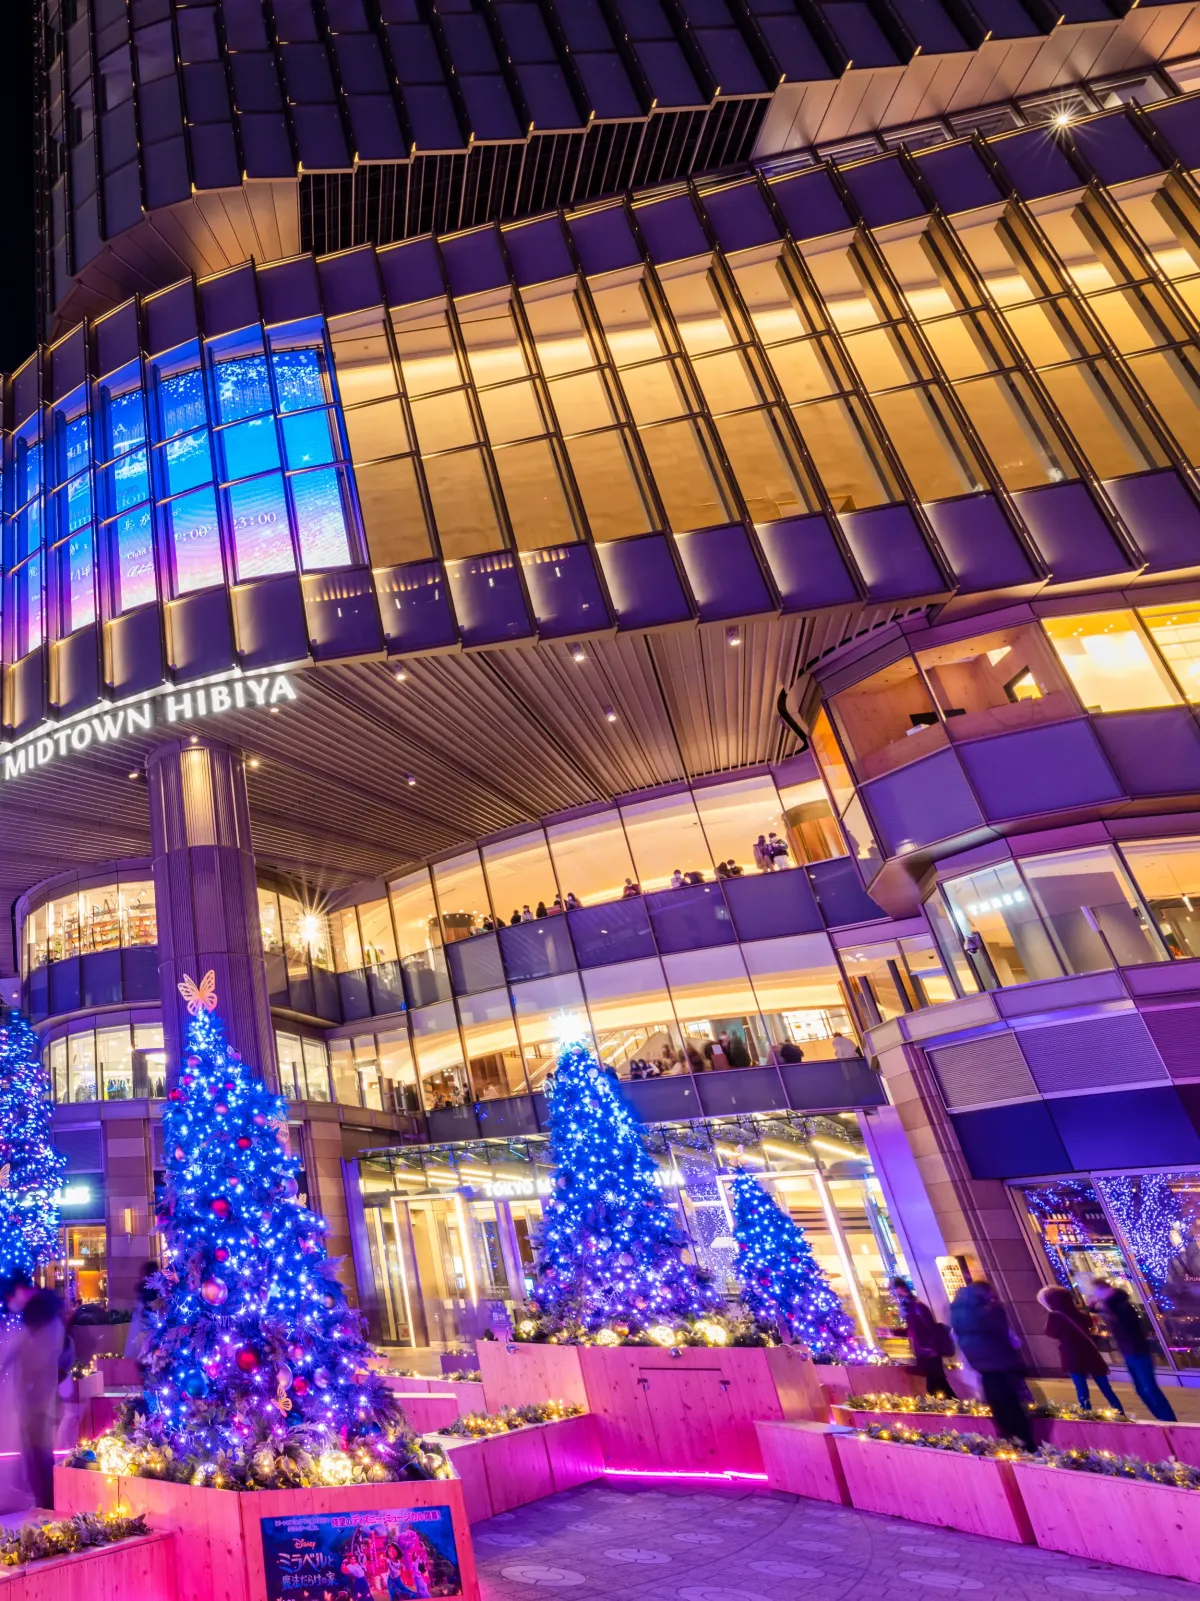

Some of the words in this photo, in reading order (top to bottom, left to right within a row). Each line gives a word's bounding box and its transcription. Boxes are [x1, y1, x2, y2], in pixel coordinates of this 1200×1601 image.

[4, 703, 151, 781] MIDTOWN
[166, 674, 297, 723] HIBIYA
[482, 1180, 535, 1198] TOKYO
[292, 1538, 316, 1550] Disney
[278, 1552, 334, 1573] ミラベルと
[281, 1570, 339, 1592] 魔法だらけの家
